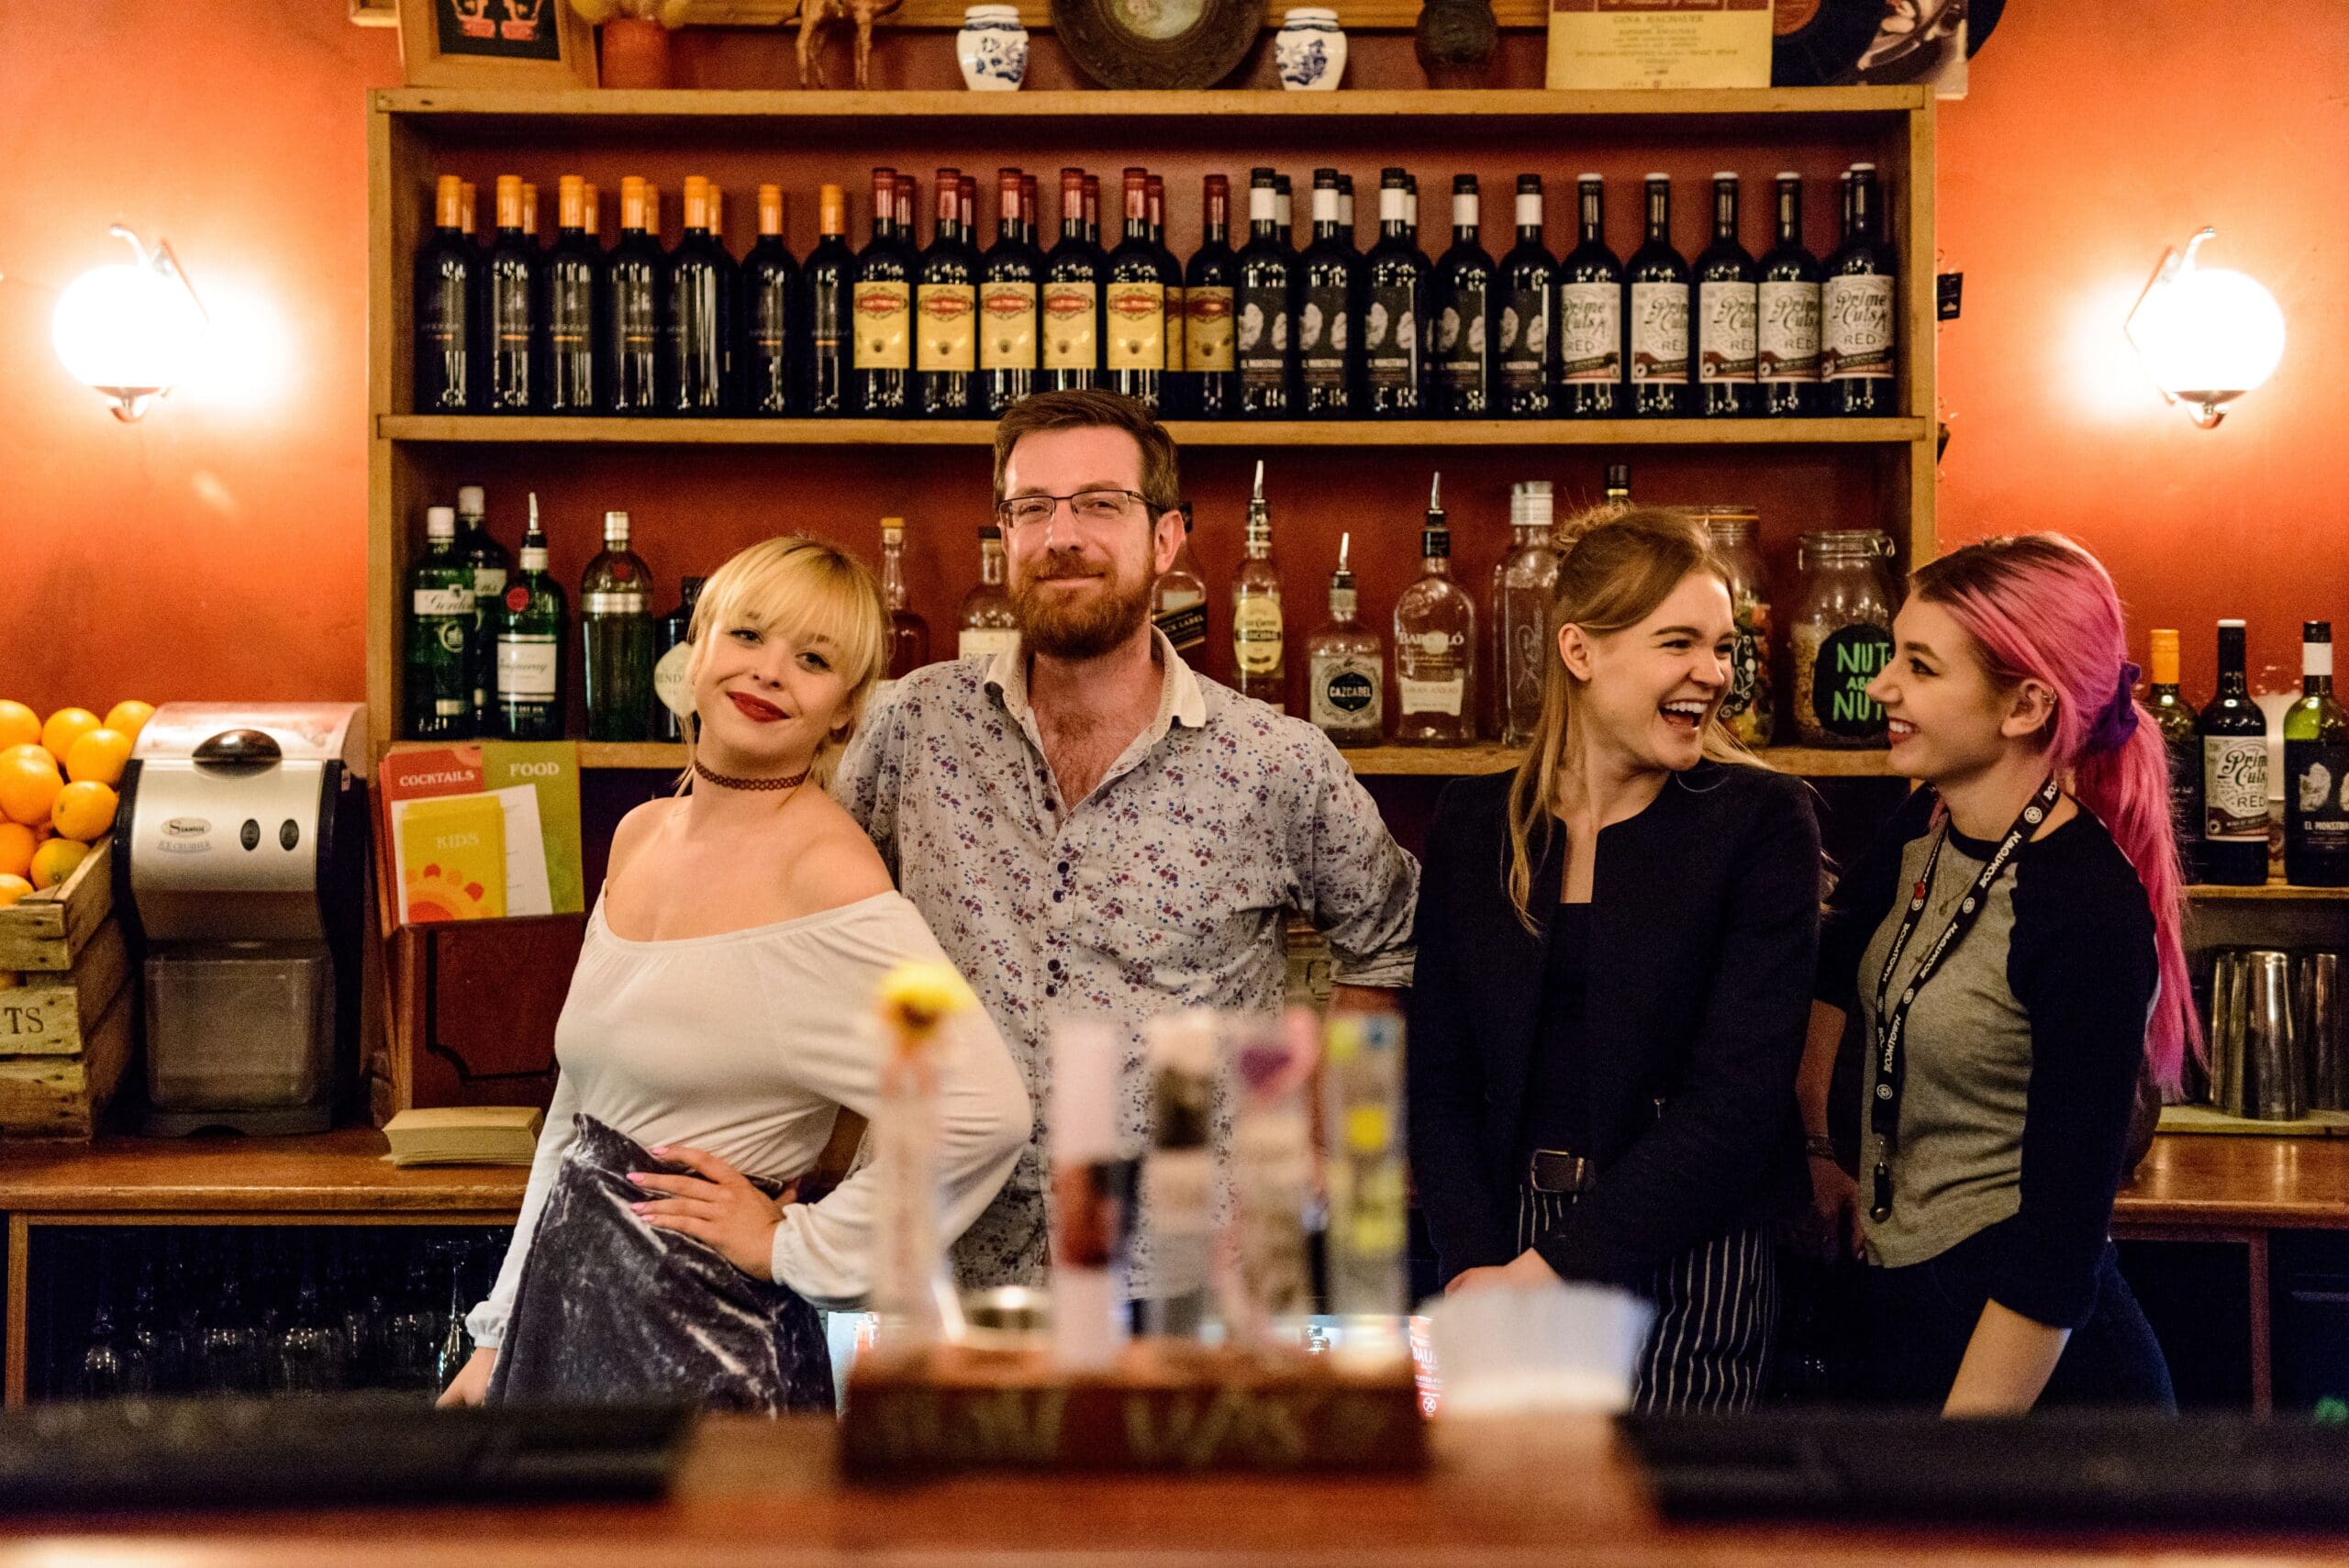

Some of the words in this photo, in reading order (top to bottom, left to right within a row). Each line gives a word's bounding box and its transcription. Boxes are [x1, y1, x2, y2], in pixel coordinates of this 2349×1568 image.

[1844, 333, 1876, 345] RED
[509, 762, 561, 777] FOOD
[2221, 750, 2267, 774] Prim
[399, 770, 475, 787] COCKTAILS
[436, 831, 479, 849] KIDS
[1979, 830, 2022, 888] BOOMTOWN
[1920, 921, 1959, 979] BOOMTOWN
[4, 1006, 44, 1035] TS
[1884, 1014, 1902, 1073] BOOMTOWN
